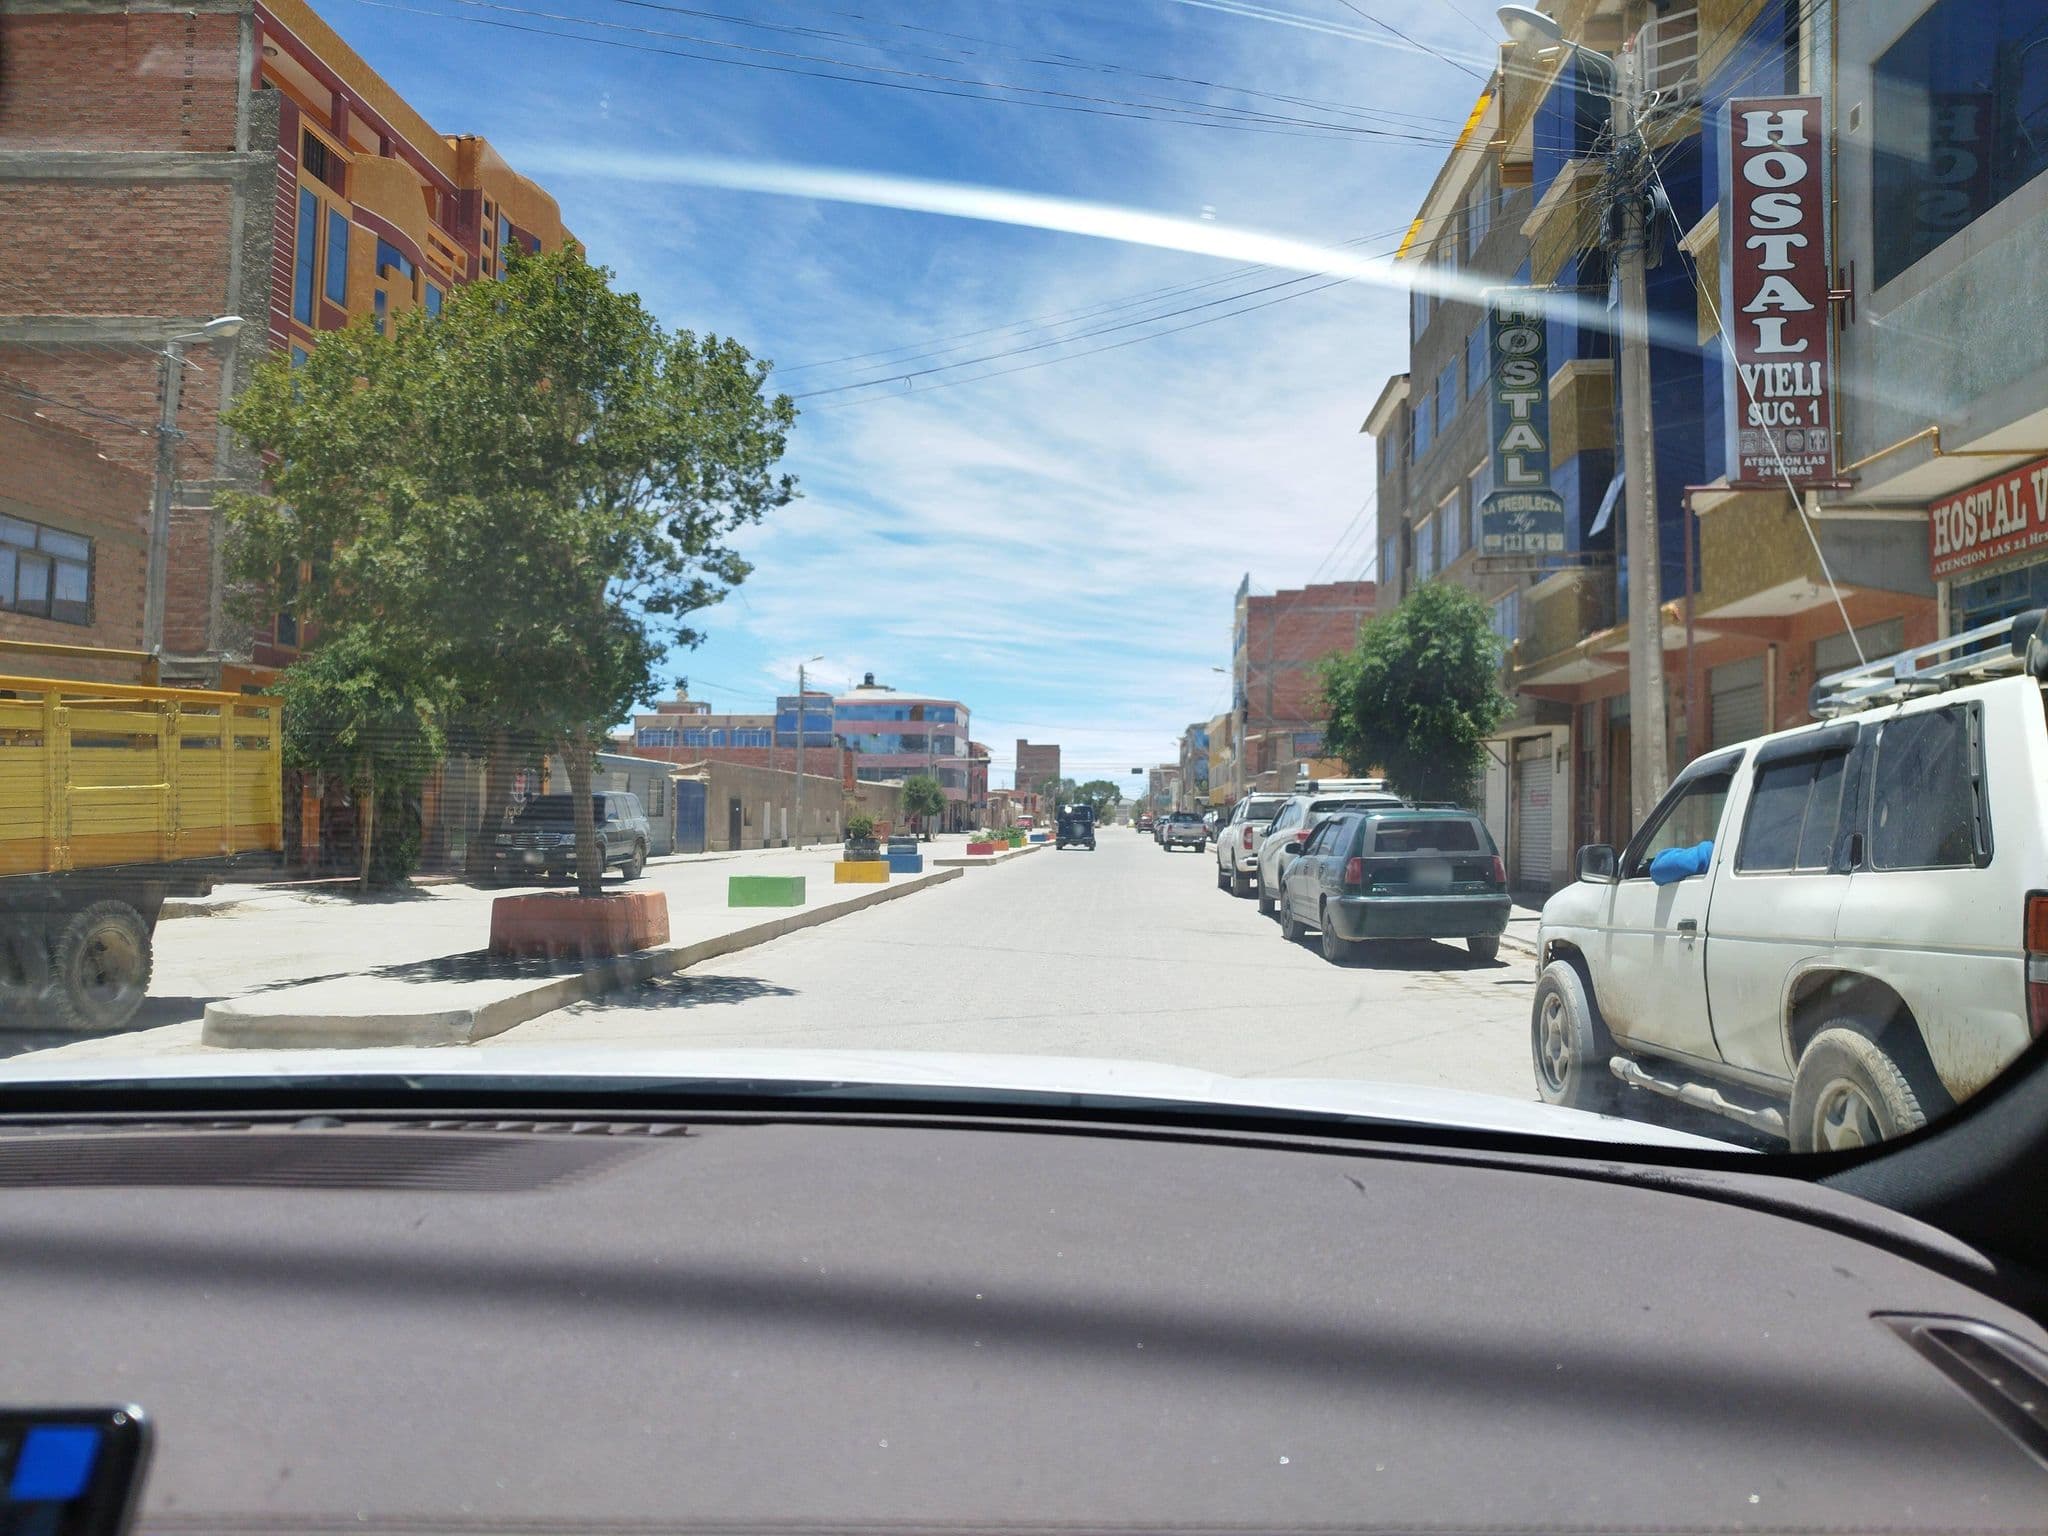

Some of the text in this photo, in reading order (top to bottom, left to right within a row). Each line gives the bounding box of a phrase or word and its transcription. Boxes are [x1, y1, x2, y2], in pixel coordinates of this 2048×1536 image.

[1741, 109, 1814, 354] HOSTAL
[1496, 295, 1545, 485] HOSTAL
[1740, 361, 1823, 398] VIELI
[1748, 400, 1819, 427] SUC. 1
[1757, 466, 1813, 477] 24 HORAS
[1804, 455, 1826, 466] LAS
[1933, 478, 2027, 557] HOSTAL
[1934, 549, 1987, 575] ATENCION
[1990, 541, 2011, 558] LAS
